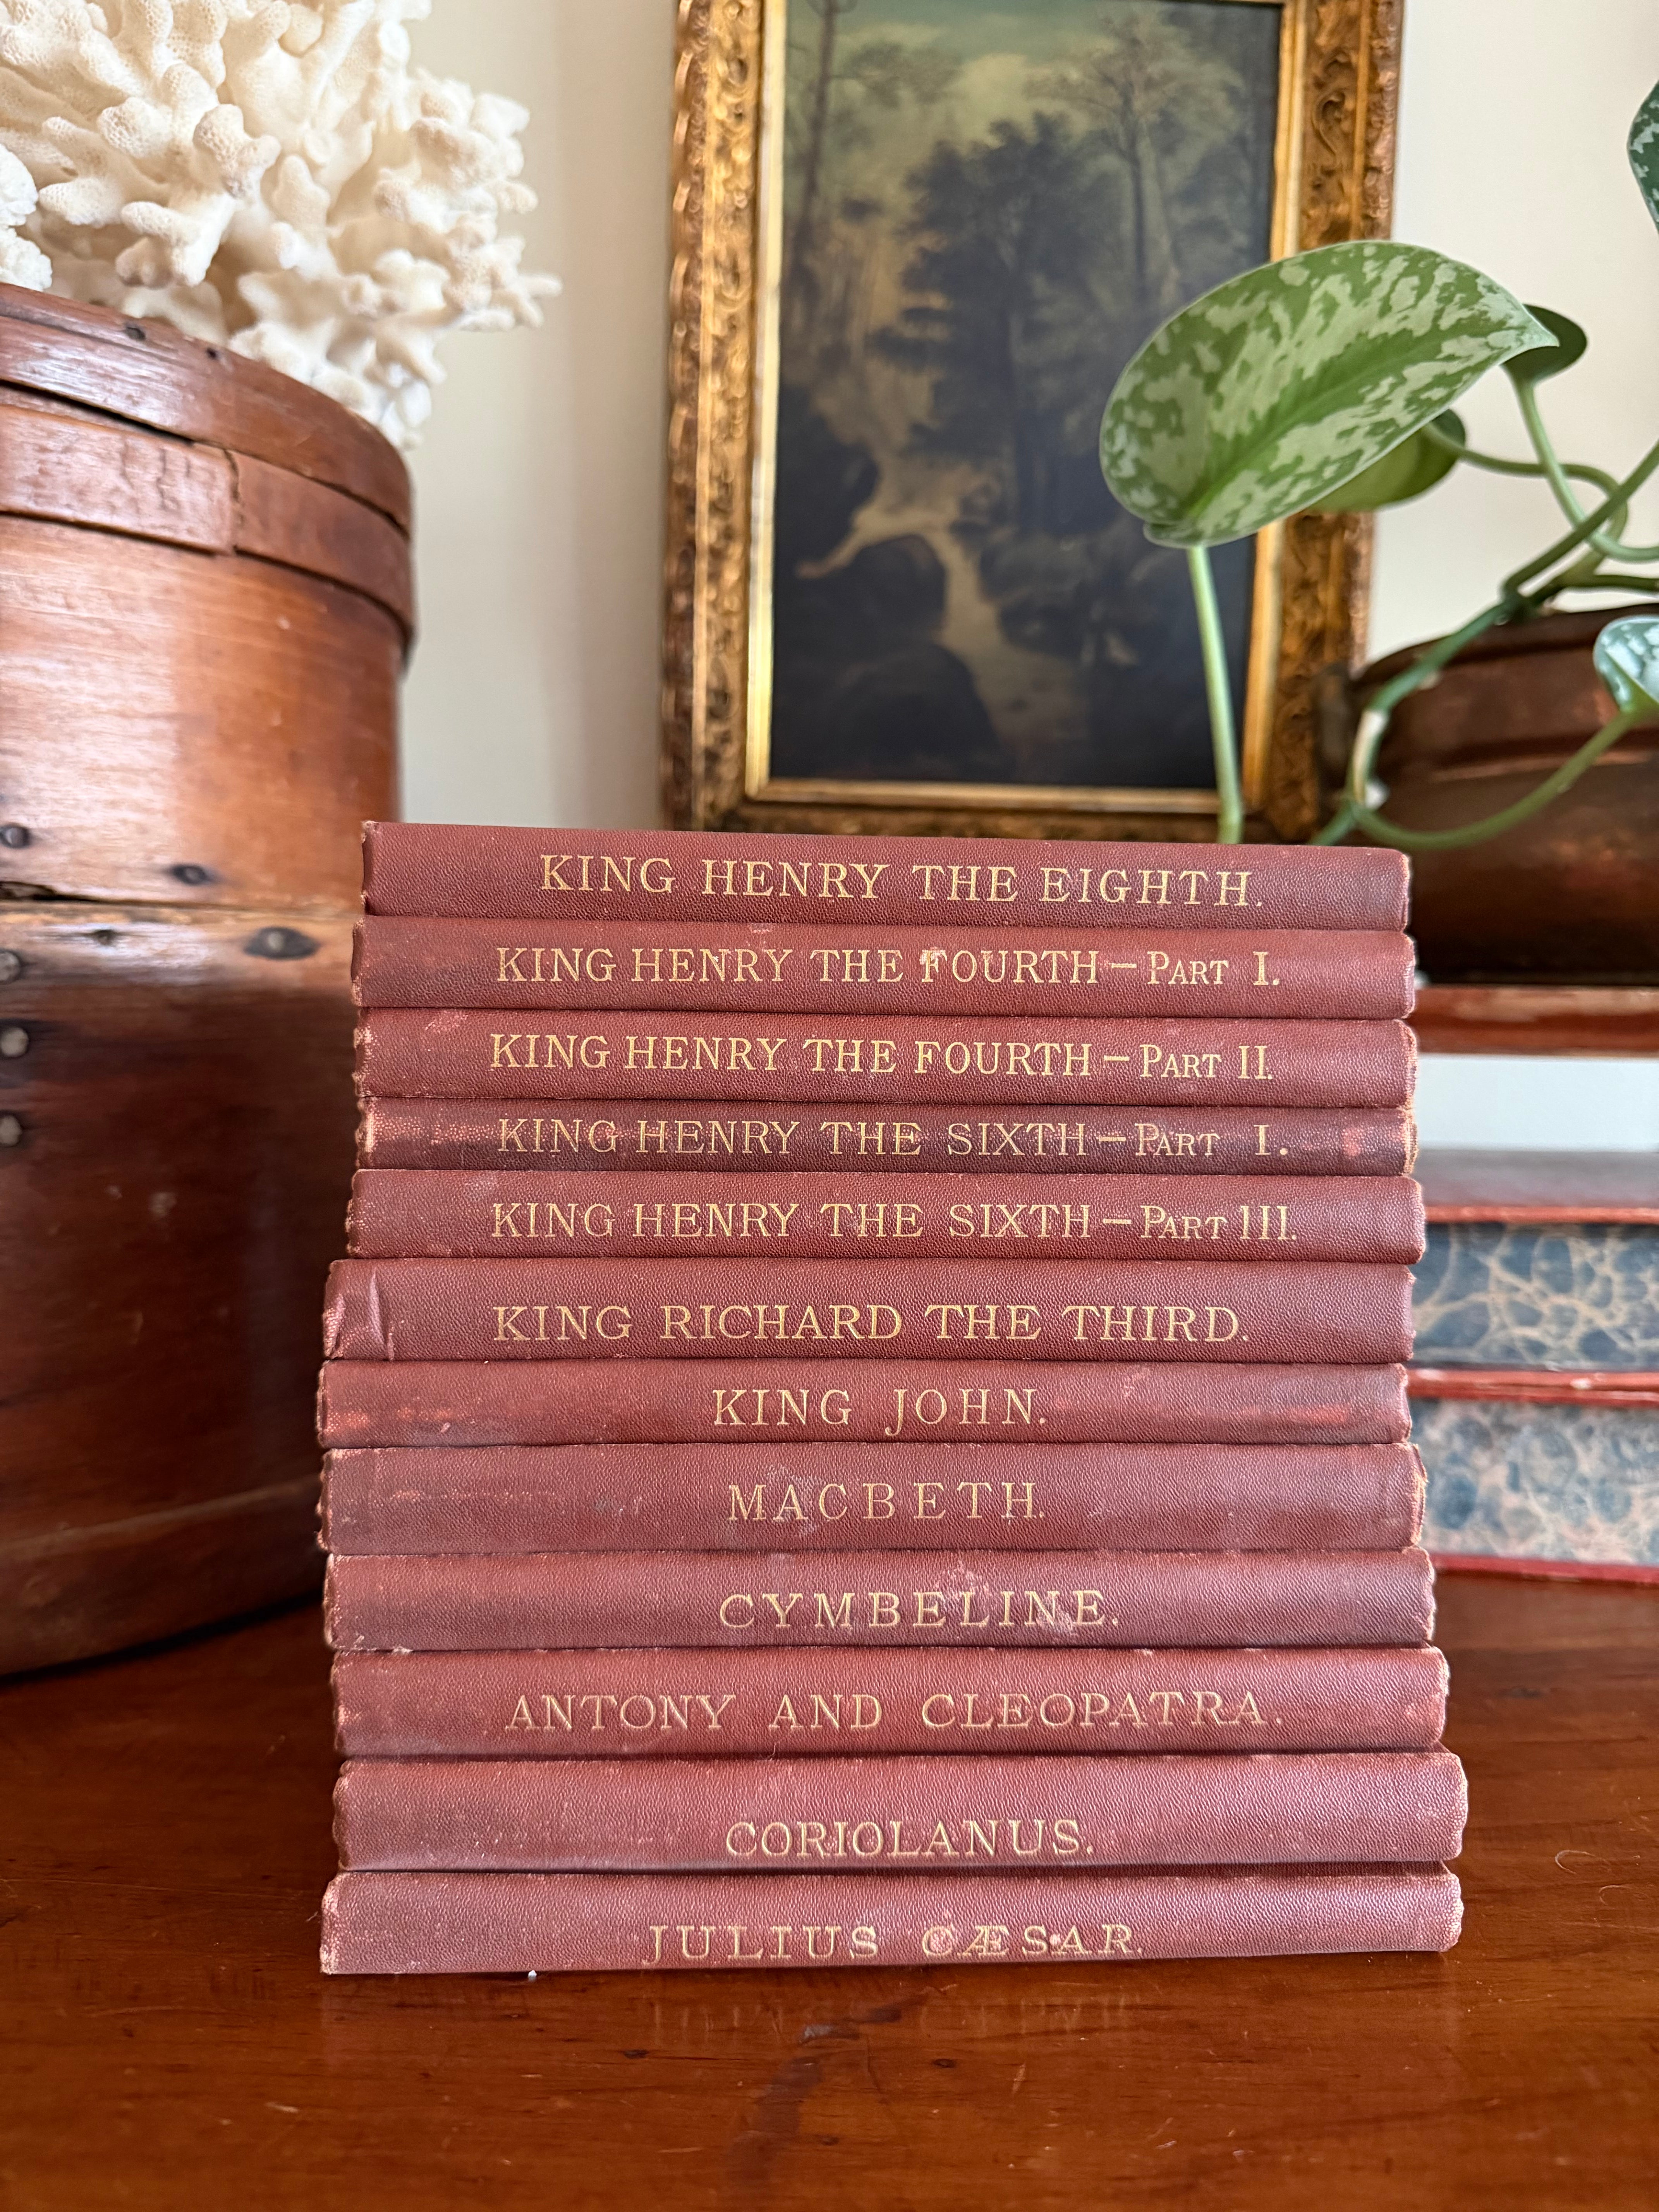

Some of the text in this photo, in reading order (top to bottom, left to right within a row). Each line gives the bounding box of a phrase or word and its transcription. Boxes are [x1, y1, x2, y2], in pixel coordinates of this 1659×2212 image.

[539, 854, 1263, 907] KING HENRY THE EIGHTH.
[497, 946, 617, 983] KING
[631, 947, 795, 982] HENRY
[809, 948, 903, 983] THE
[1252, 950, 1280, 986] I.
[489, 1034, 611, 1070] KING
[624, 1036, 788, 1070] HENRY
[802, 1037, 896, 1072] THE
[1237, 1045, 1273, 1080] II.
[497, 1117, 621, 1152] KING
[634, 1120, 800, 1153] HENRY
[820, 1121, 921, 1155] THE
[1254, 1123, 1289, 1156] I.
[491, 1201, 615, 1238] KING
[632, 1203, 800, 1237] HENRY
[819, 1202, 923, 1238] THE
[1240, 1205, 1298, 1242] III.
[493, 1304, 1248, 1343] KING RICHARD THE THIRD.
[713, 1388, 1048, 1436] KING JOHN.
[726, 1480, 1046, 1521] MACBETH.
[719, 1590, 1120, 1629] CYMBELINE.
[505, 1690, 1284, 1732] ANTONY AND CLEOPATRA.
[726, 1819, 1093, 1858] CORIOLANUS.
[642, 1924, 879, 1964] JULIUS
